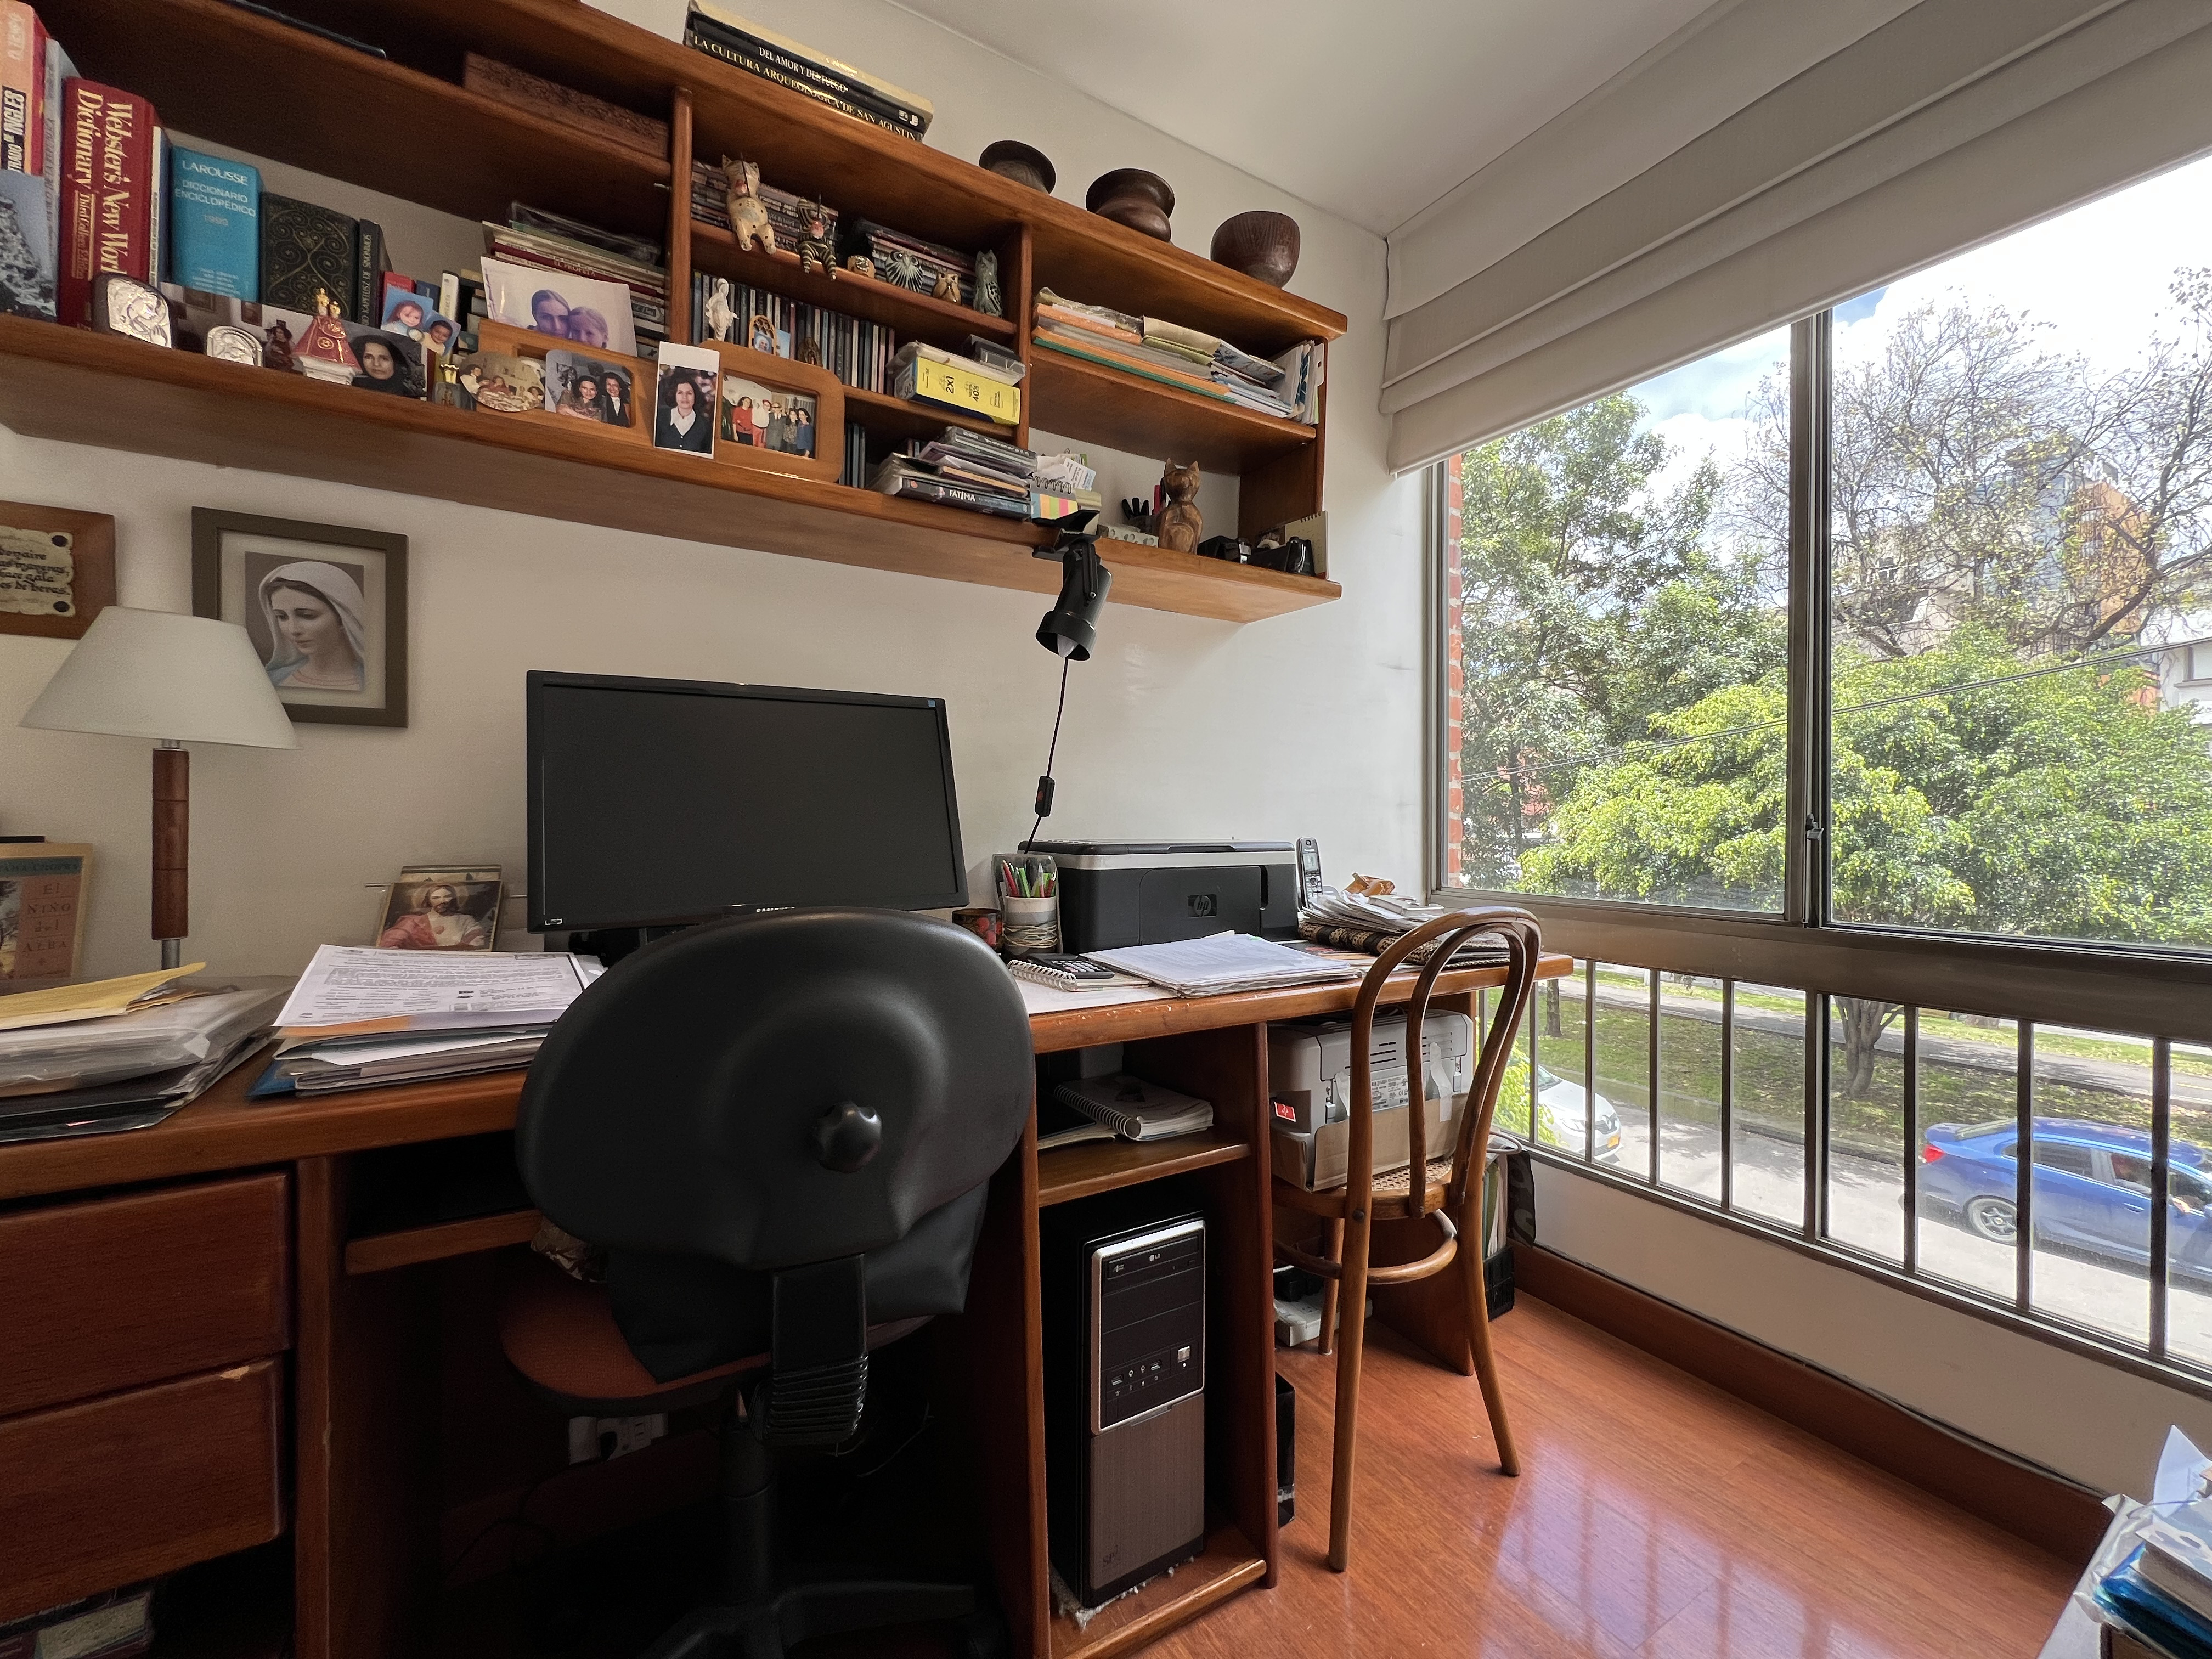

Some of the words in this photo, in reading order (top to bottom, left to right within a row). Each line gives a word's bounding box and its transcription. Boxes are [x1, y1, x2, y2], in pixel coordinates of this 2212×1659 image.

[694, 36, 709, 50] LA
[711, 43, 760, 72] CULTURA
[842, 103, 855, 115] DE
[857, 110, 876, 123] SAN
[758, 46, 774, 61] DEL
[775, 55, 799, 72] AMOR
[799, 65, 805, 75] Y
[67, 88, 104, 190] Dictionary
[102, 102, 133, 185] Webster's
[182, 160, 249, 187] LAROUSSE
[182, 179, 249, 204] DICCIONARIO
[102, 184, 130, 232] New
[100, 232, 129, 274] Worl
